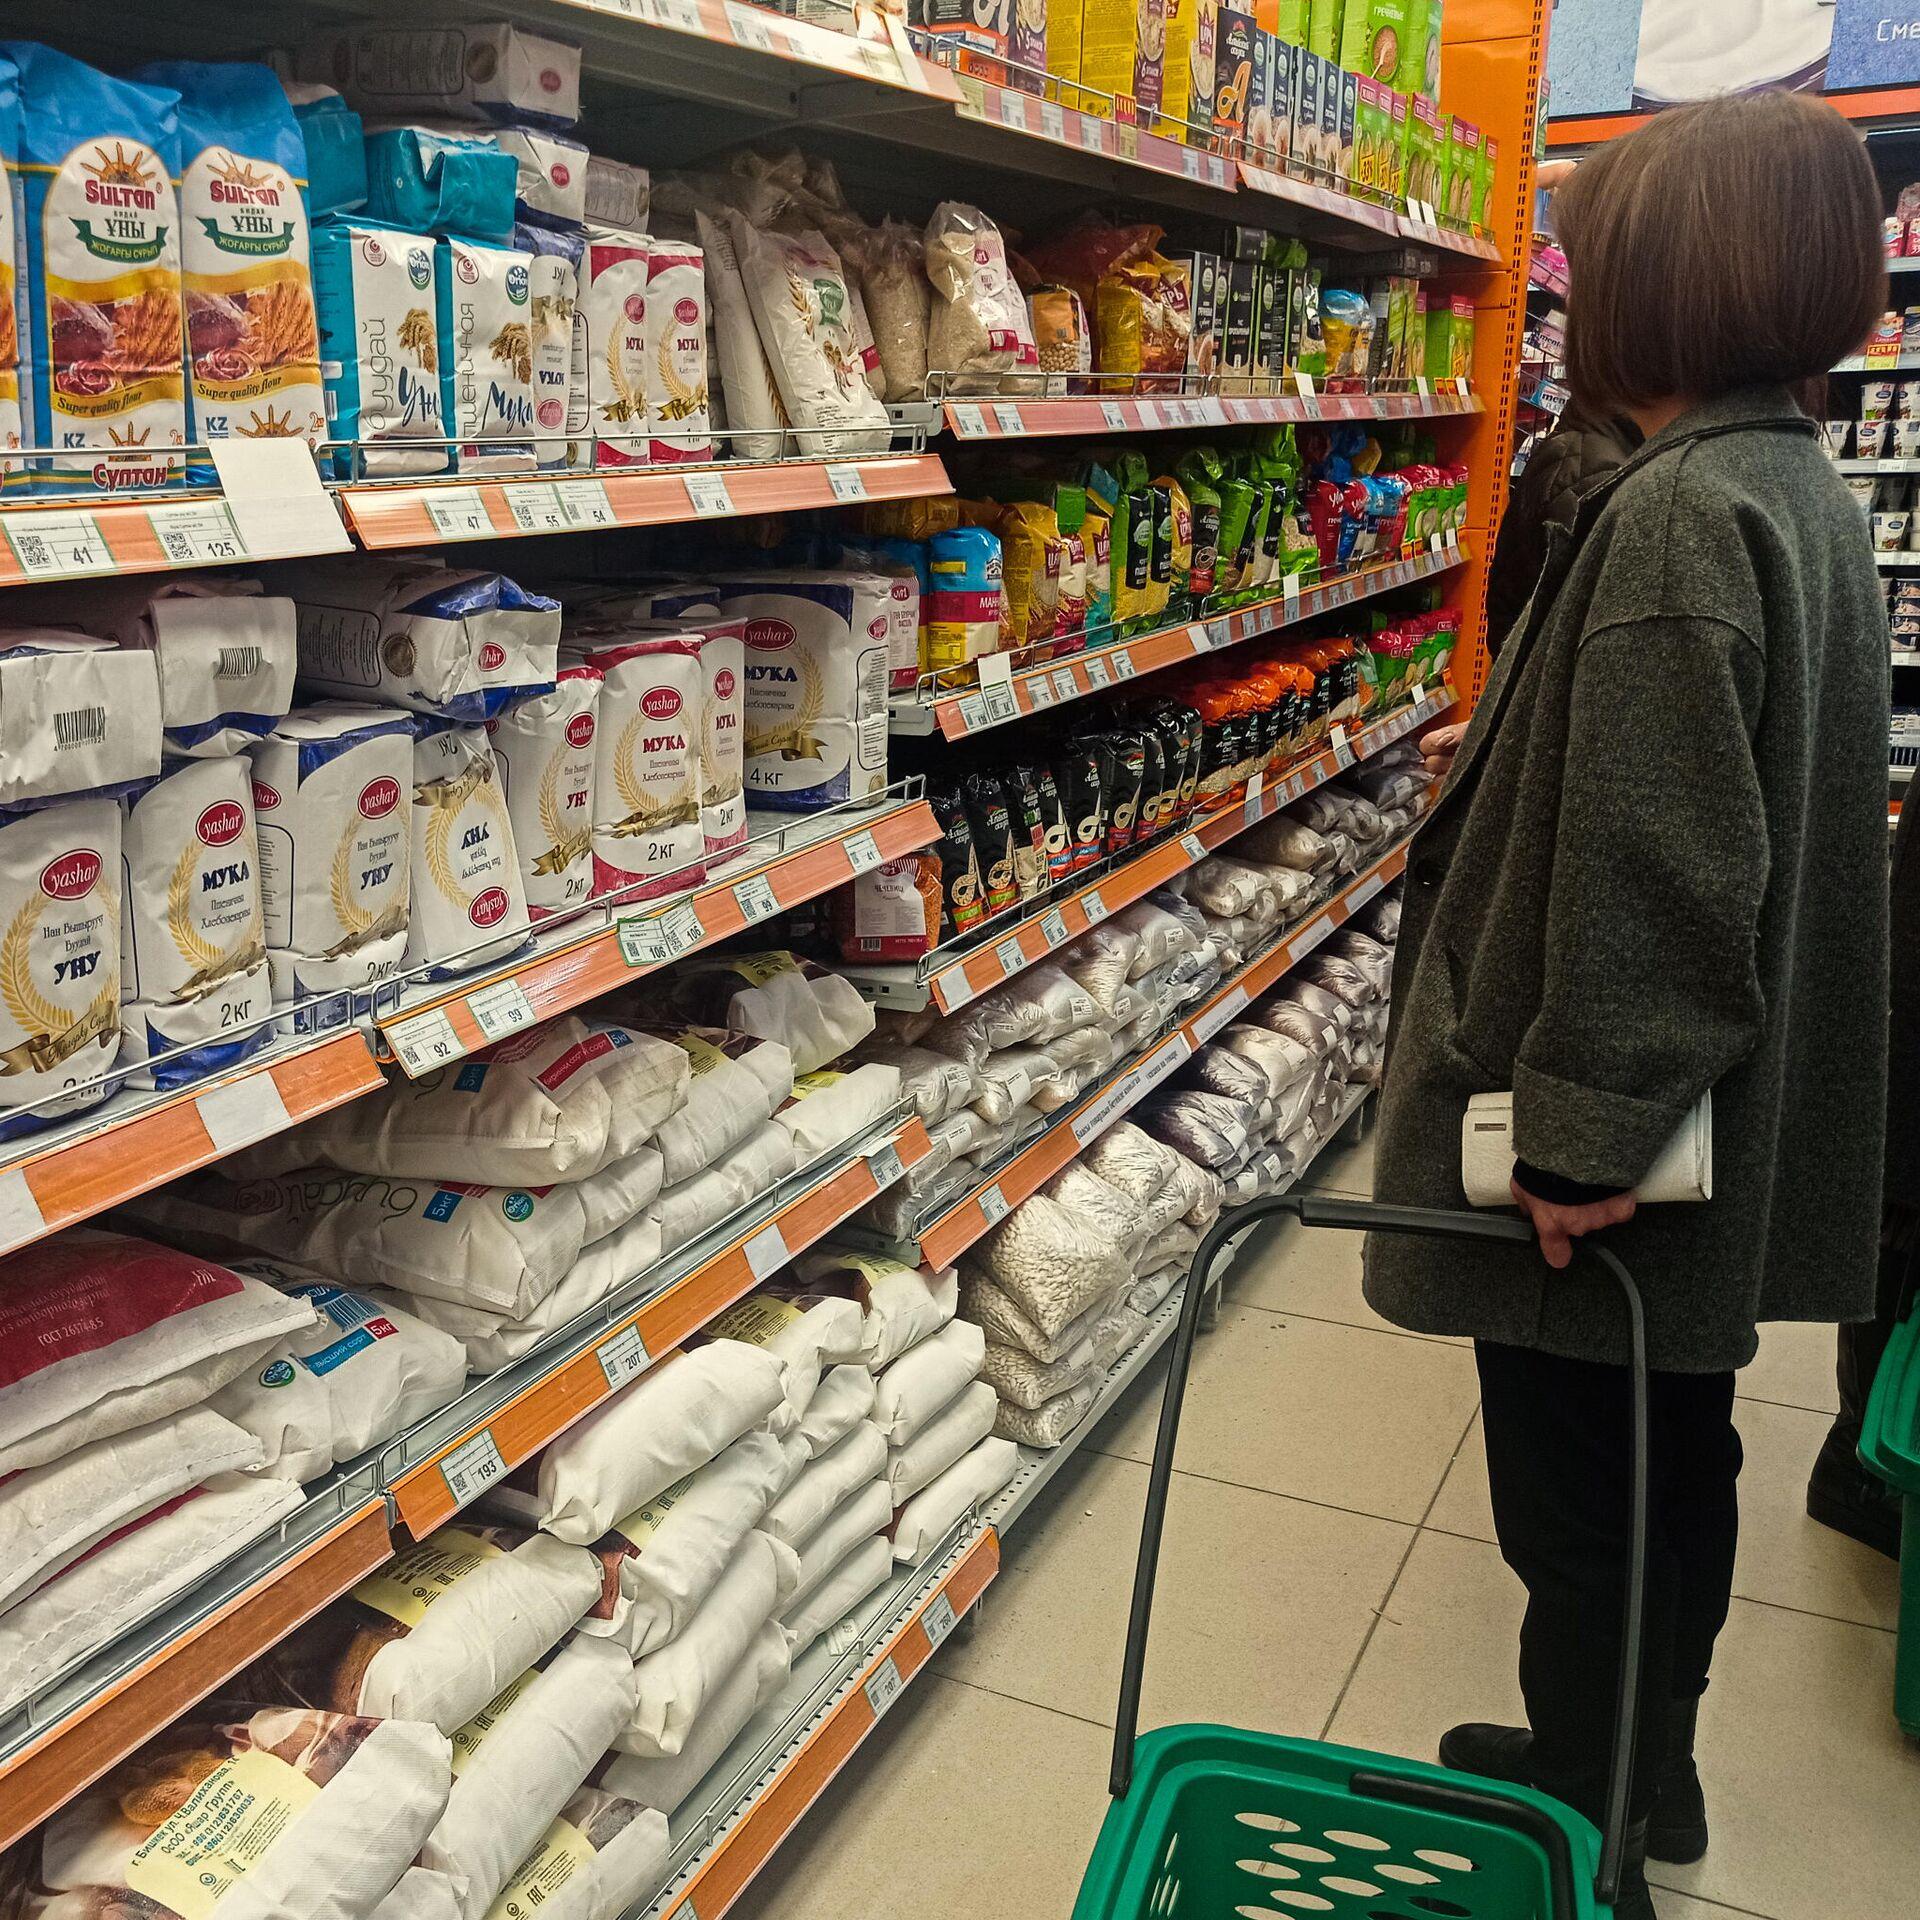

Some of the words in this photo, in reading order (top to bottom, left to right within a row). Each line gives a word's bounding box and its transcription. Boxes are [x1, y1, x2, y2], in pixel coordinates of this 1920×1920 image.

[198, 383, 228, 400] Super
[230, 384, 260, 399] quality
[260, 376, 282, 393] flour
[58, 397, 88, 414] Super
[90, 400, 120, 415] quality
[120, 391, 143, 410] flour
[206, 417, 228, 432] KZ
[467, 515, 481, 531] 47
[545, 515, 560, 528] 55
[593, 510, 607, 523] 54
[73, 546, 94, 566] 41
[207, 542, 236, 559] 125
[646, 695, 679, 713] yashar
[643, 734, 686, 754] МУКА
[750, 767, 760, 784] 4
[364, 788, 397, 811] yashar
[203, 812, 242, 842] yashar
[461, 822, 490, 850] УНУ
[51, 864, 98, 892] yashar
[202, 861, 250, 893] МУКА
[360, 863, 394, 891] УНУ
[475, 889, 504, 918] yashar
[43, 925, 61, 940] Нан
[686, 925, 701, 942] 106
[650, 946, 666, 959] 106
[54, 951, 101, 985] УНУ
[433, 1042, 451, 1058] 92
[432, 1193, 453, 1217] 5кг
[37, 1328, 62, 1347] ГОСТ
[371, 1321, 395, 1337] 5кг
[625, 1351, 642, 1371] 207
[476, 1460, 497, 1482] 193
[161, 1833, 186, 1855] ОсОО
[207, 1780, 236, 1814] Групп»
[136, 1829, 169, 1860] Бишкек
[166, 1816, 182, 1834] ул.
